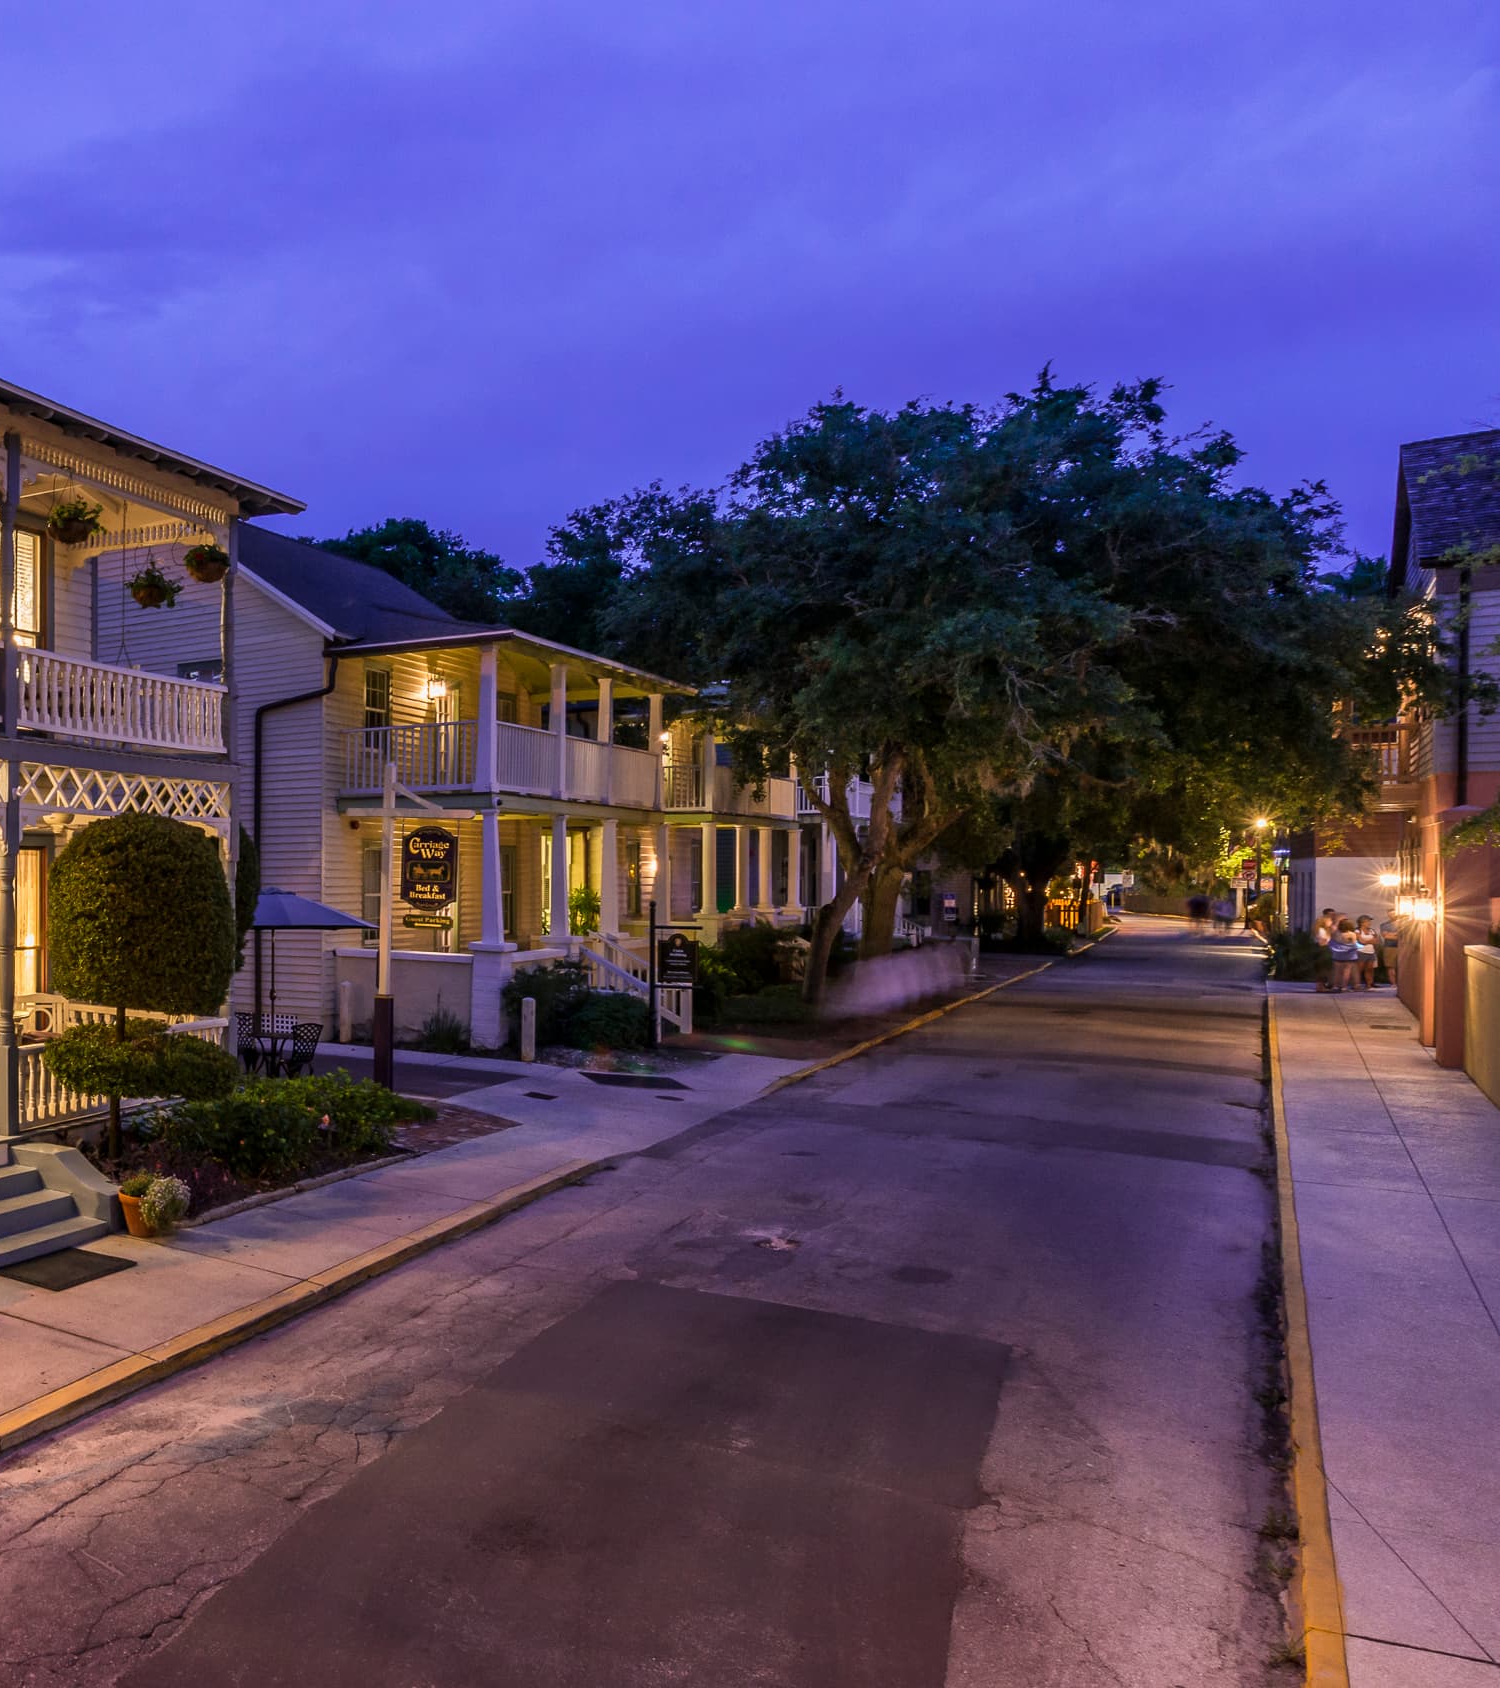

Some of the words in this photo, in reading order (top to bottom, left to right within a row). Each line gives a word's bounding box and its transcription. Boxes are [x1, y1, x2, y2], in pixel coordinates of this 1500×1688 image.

[409, 837, 450, 855] Carriage
[420, 848, 447, 859] Way
[415, 884, 430, 892] Bed
[431, 884, 439, 892] &
